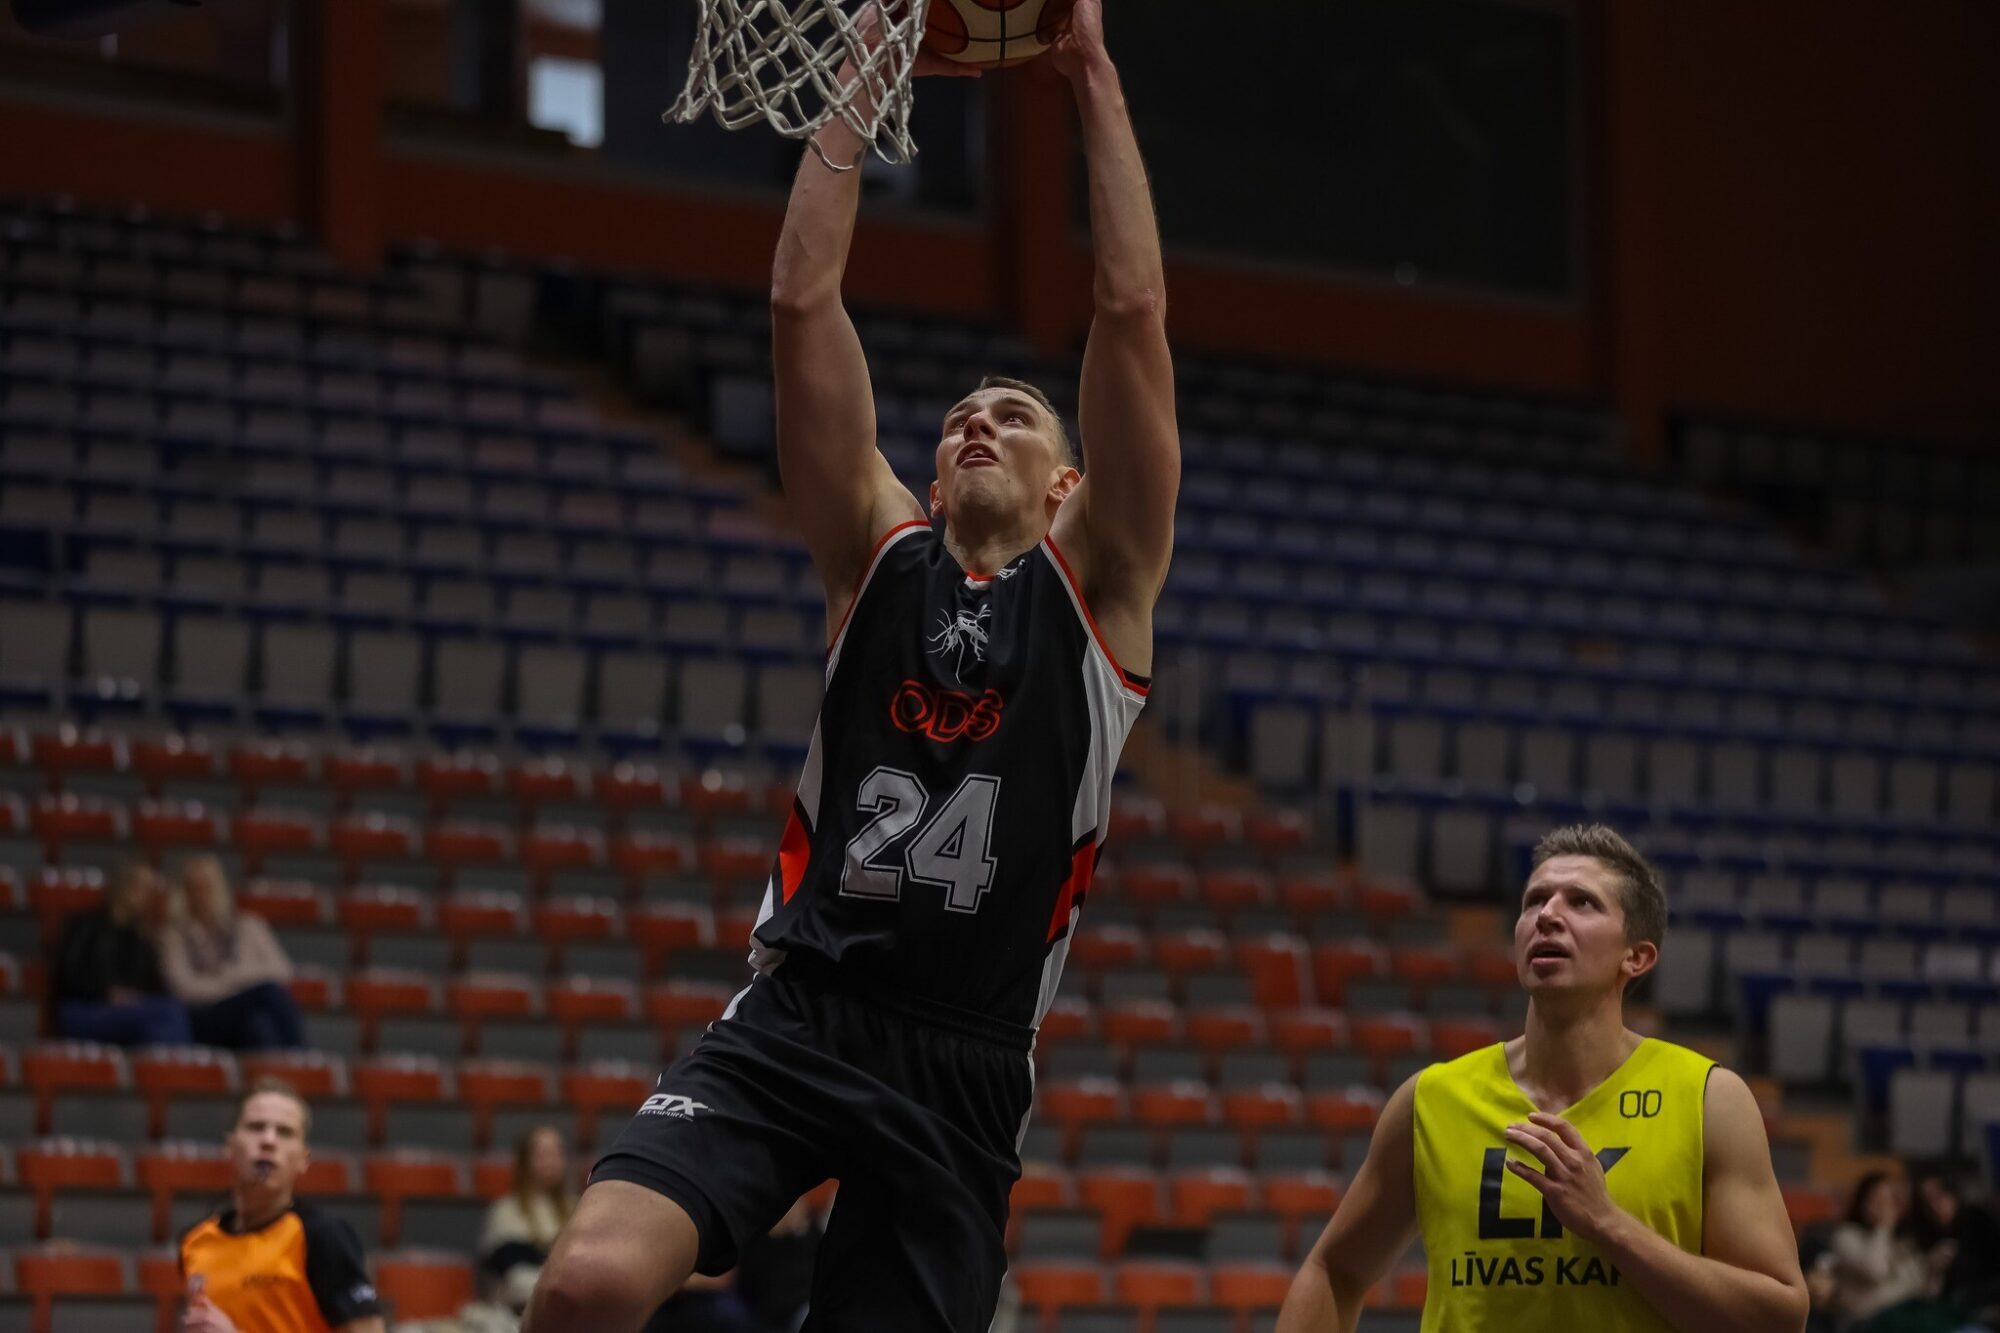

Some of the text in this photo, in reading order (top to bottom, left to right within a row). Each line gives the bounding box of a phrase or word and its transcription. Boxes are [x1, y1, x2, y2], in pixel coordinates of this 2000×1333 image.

[891, 680, 1004, 742] ODS
[838, 766, 1001, 914] 24
[1451, 1251, 1545, 1287] LĪVAS
